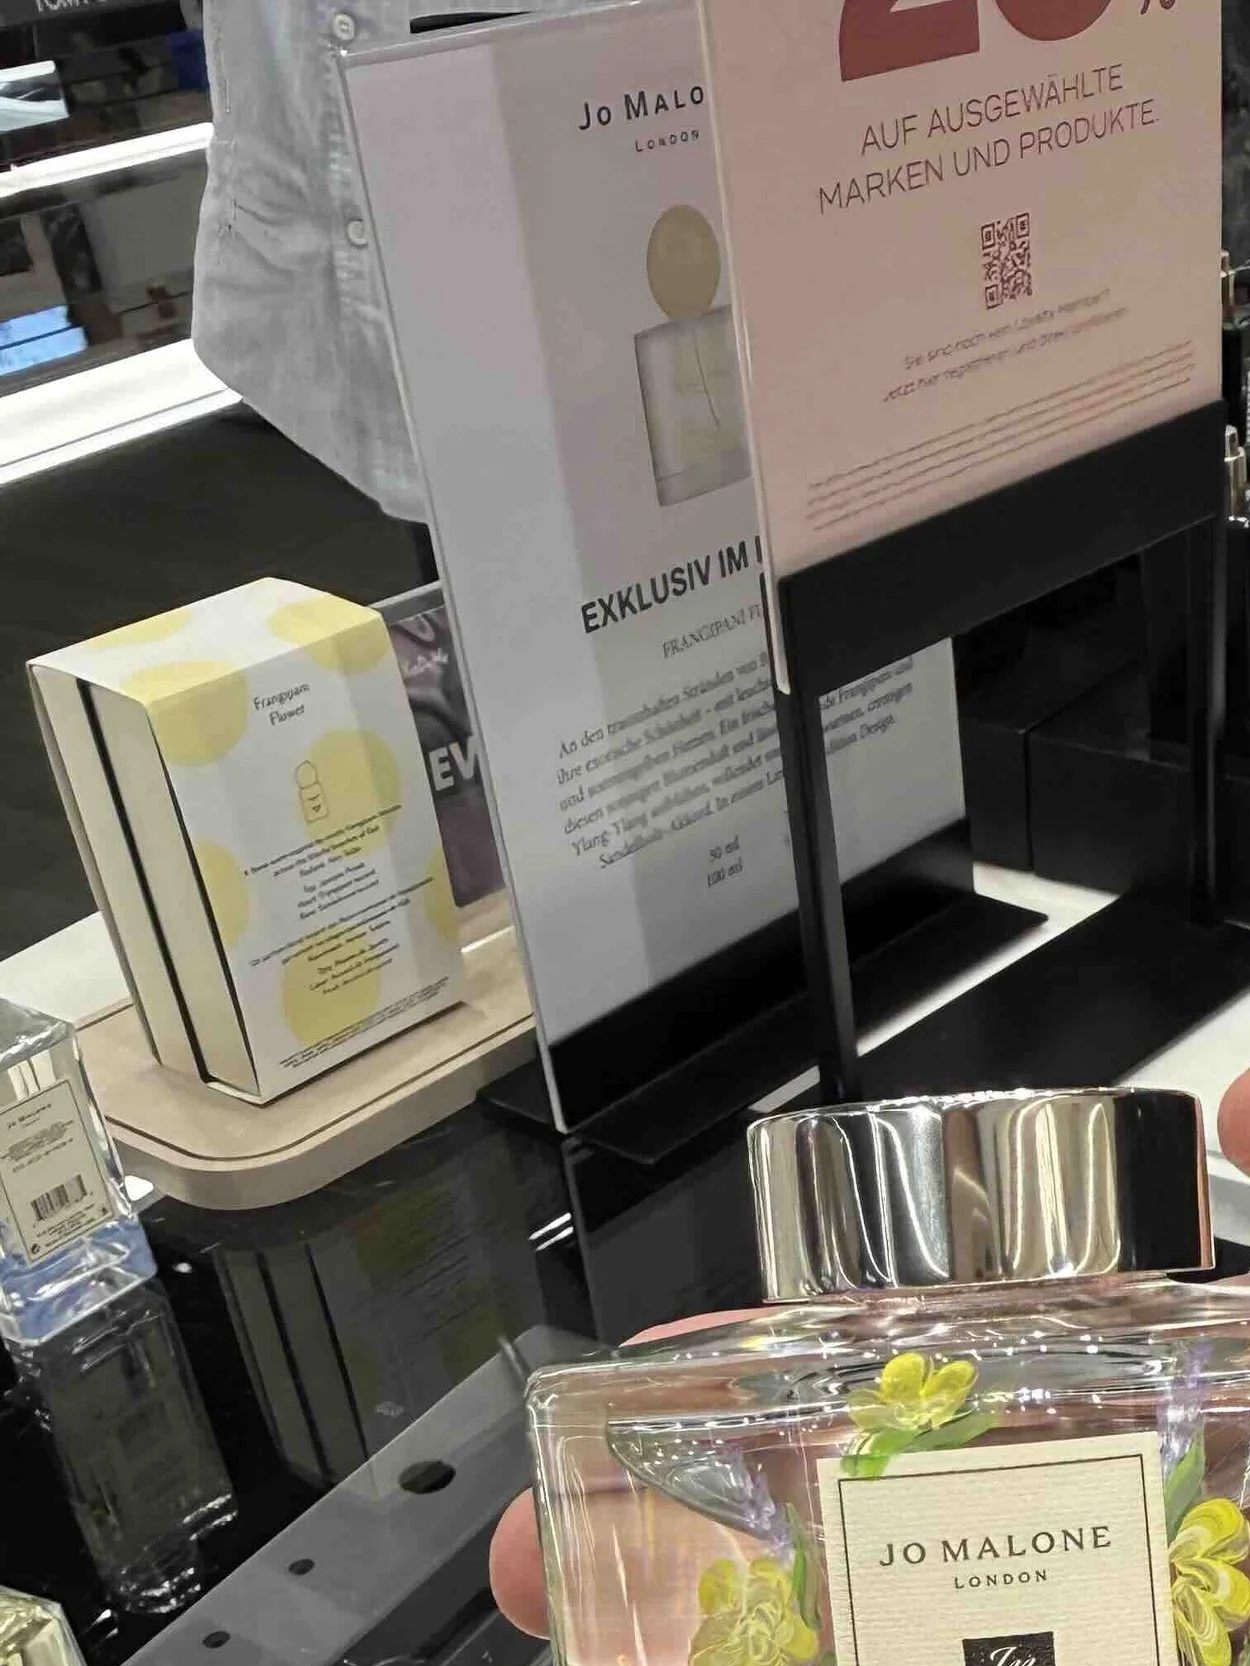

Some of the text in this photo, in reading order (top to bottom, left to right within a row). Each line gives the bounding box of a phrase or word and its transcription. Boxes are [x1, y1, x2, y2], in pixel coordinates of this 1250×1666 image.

[624, 85, 705, 121] MALO
[861, 62, 1125, 156] AUF AUSGEWÄHLTE
[634, 129, 700, 153] LONDON
[819, 154, 944, 215] MARKEN
[953, 137, 1010, 177] UND
[580, 554, 711, 634] EXKLUSIV
[717, 540, 749, 579] IM
[879, 1525, 1112, 1567] JO MALONE
[954, 1569, 1047, 1590] LONDON
